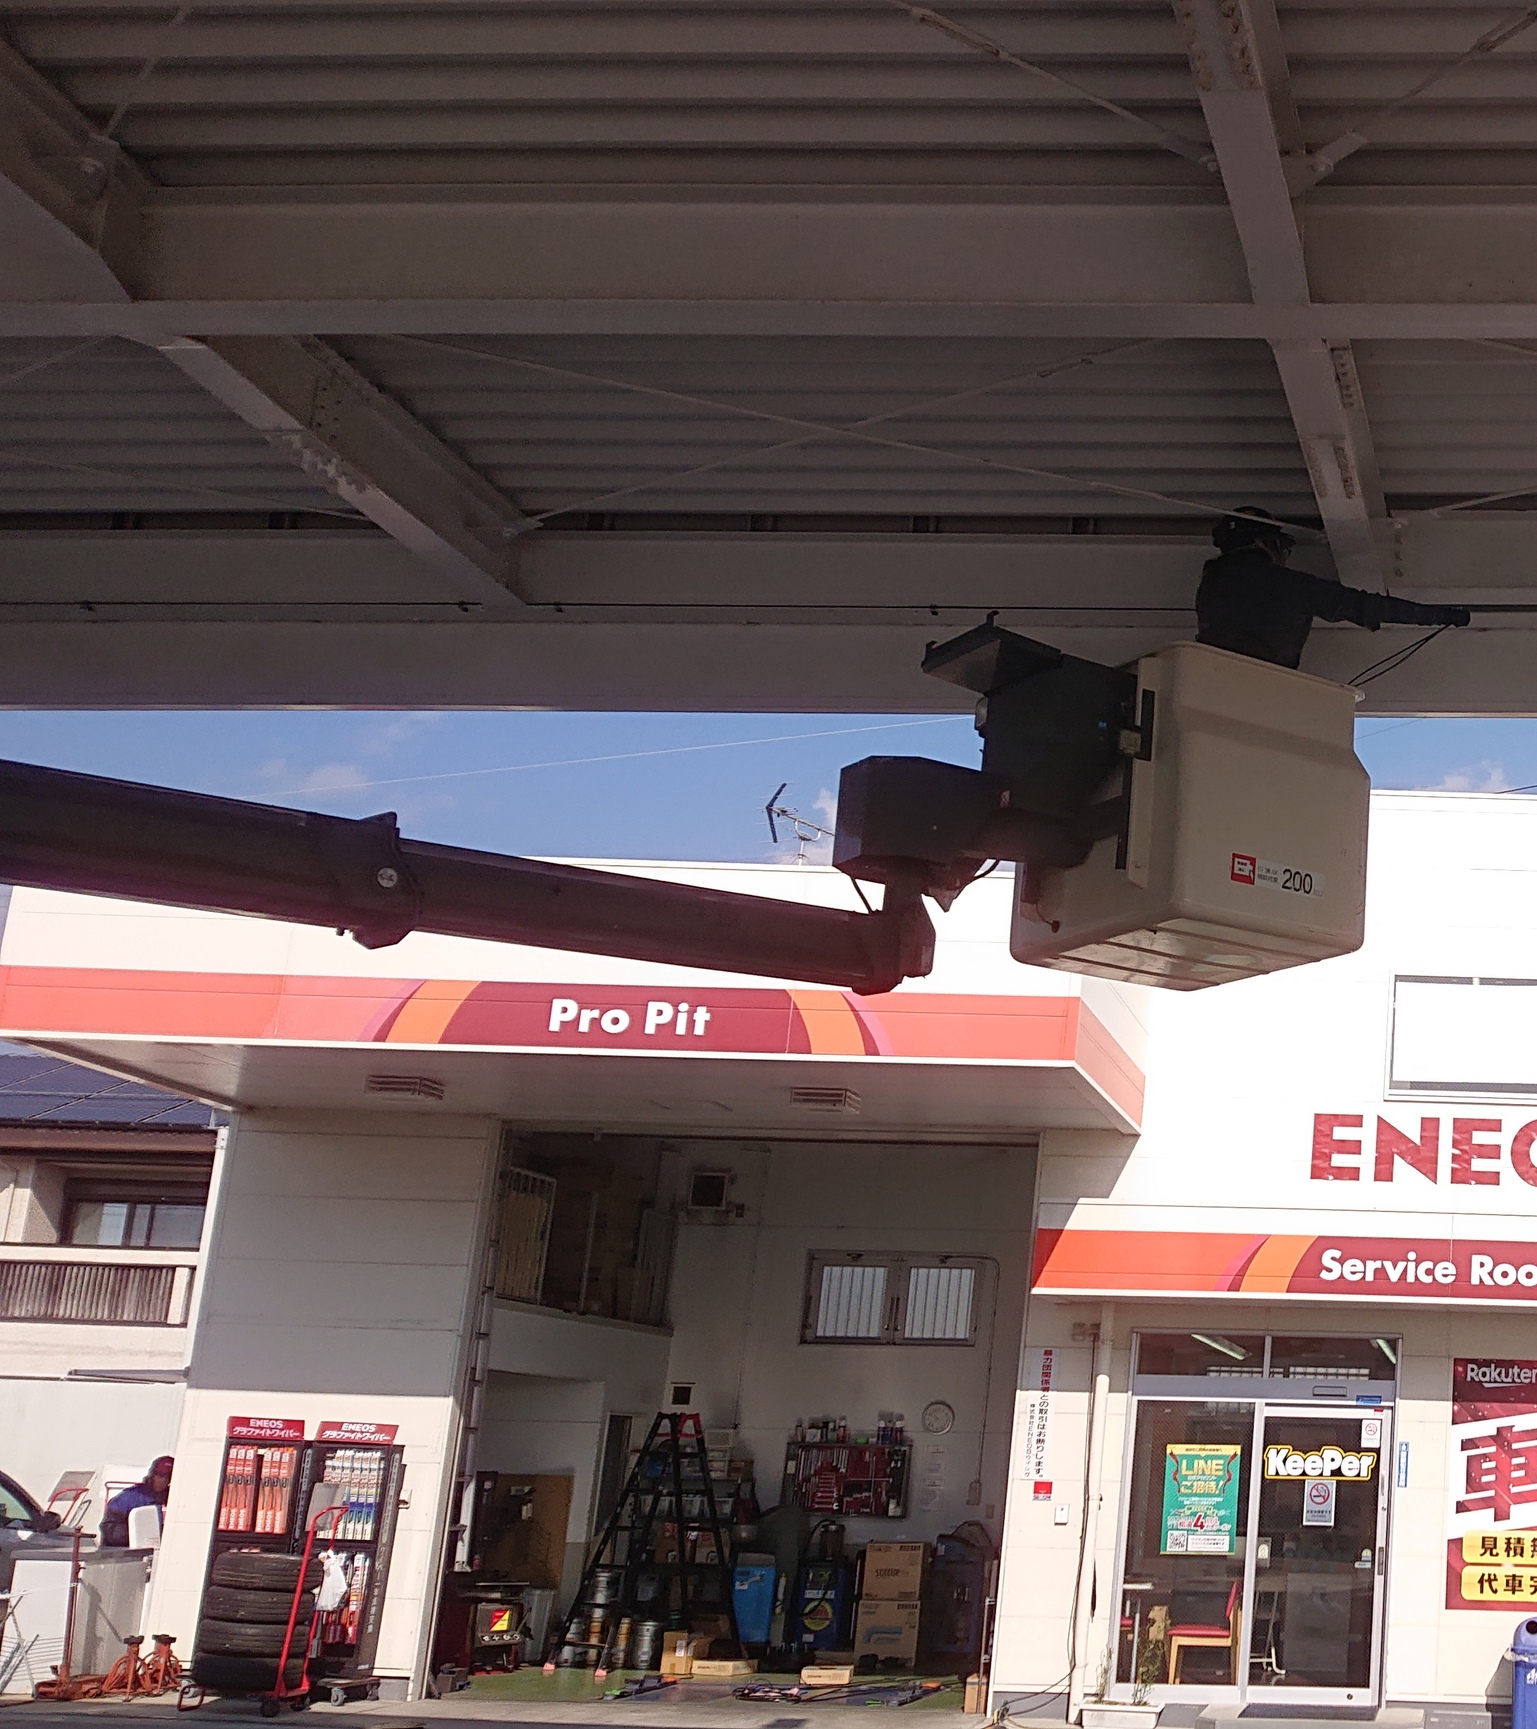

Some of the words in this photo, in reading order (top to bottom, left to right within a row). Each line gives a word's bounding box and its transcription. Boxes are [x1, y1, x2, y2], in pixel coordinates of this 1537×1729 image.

[1281, 868, 1313, 895] 200
[548, 998, 630, 1035] Pro
[643, 1000, 711, 1036] Pit
[1319, 1247, 1457, 1285] Service
[250, 1419, 283, 1429] ENEOS
[341, 1422, 376, 1432] ENEOS
[1181, 1459, 1224, 1476] LINE
[1266, 1447, 1374, 1477] KeePer
[1193, 1513, 1205, 1530] 4
